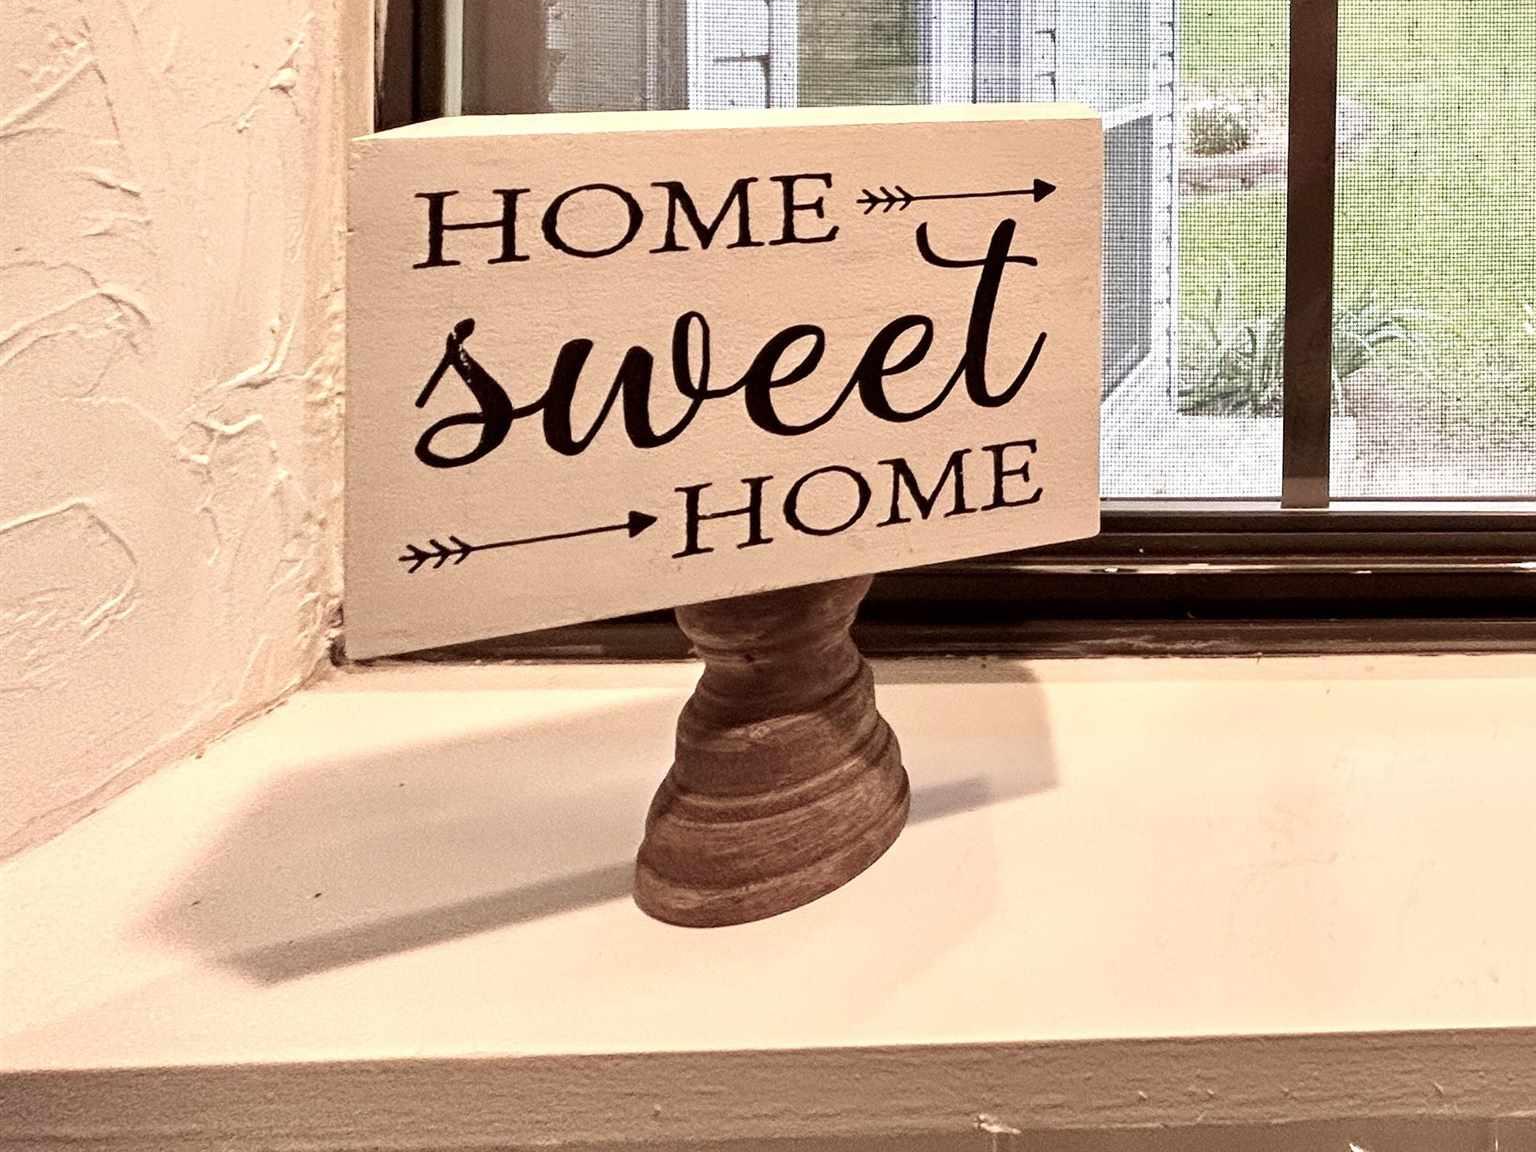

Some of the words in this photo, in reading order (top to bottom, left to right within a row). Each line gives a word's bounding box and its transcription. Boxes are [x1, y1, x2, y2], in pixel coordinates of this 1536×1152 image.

[412, 172, 840, 270] HOME
[414, 218, 1049, 469] sweet
[671, 438, 1044, 560] HOME
